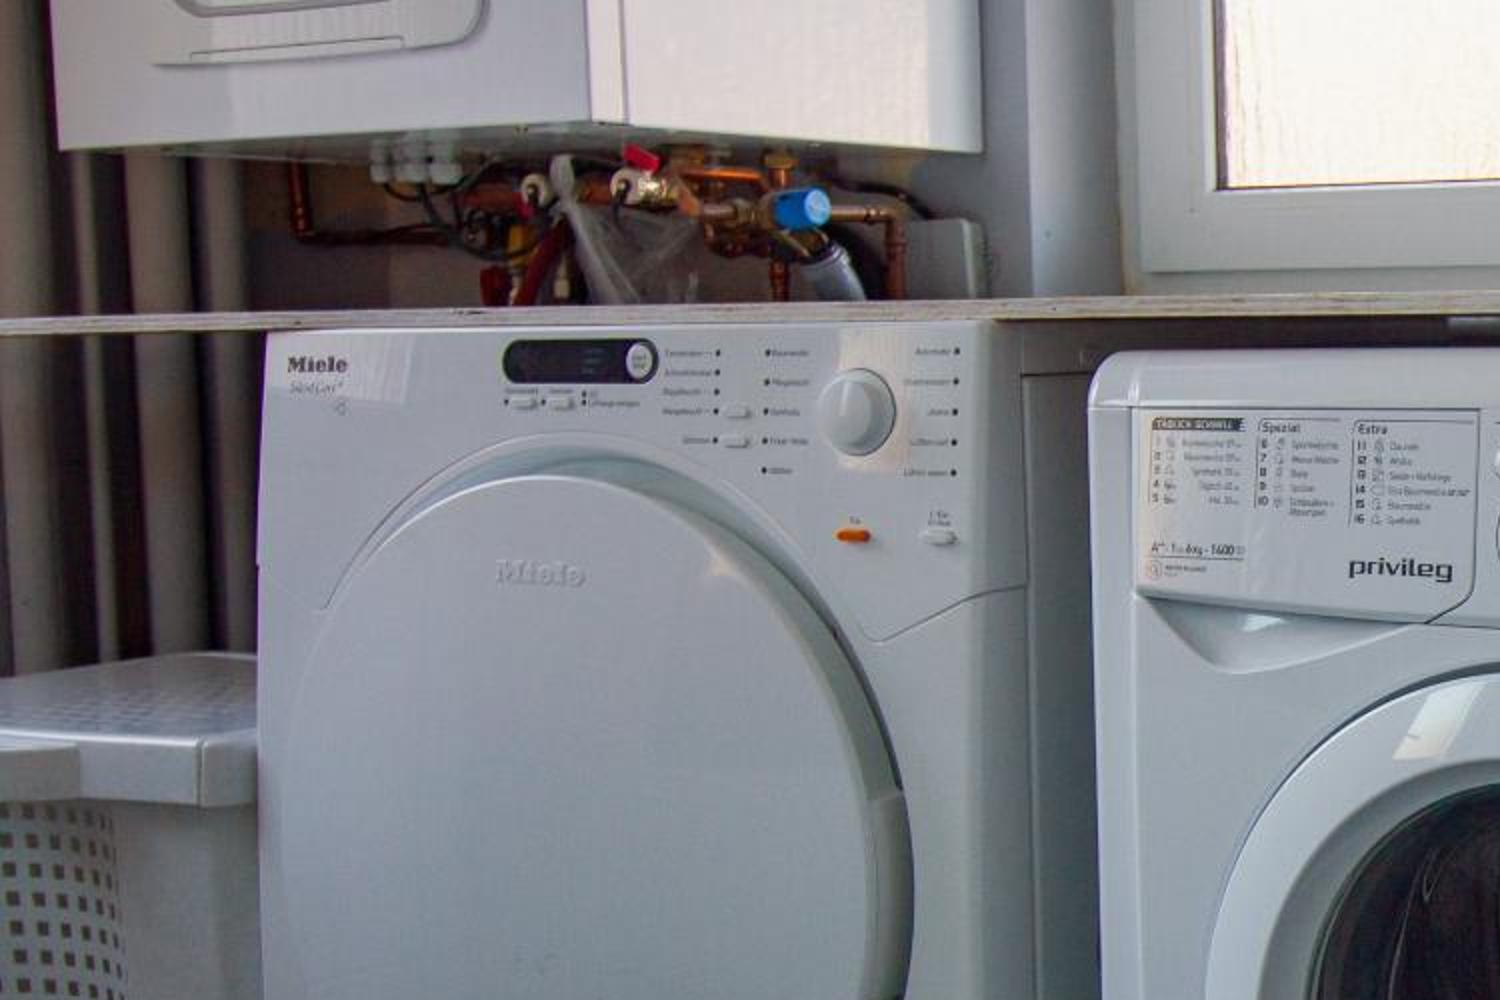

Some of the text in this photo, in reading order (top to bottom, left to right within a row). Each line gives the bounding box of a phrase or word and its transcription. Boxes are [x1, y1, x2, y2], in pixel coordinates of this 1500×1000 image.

[287, 354, 348, 373] Miele
[1262, 421, 1301, 434] Spezial
[1358, 423, 1388, 435] Extra
[1357, 440, 1367, 451] 11
[1355, 484, 1366, 494] 14
[1258, 495, 1269, 506] 10
[496, 559, 587, 589] Miele
[1349, 557, 1453, 583] privileg
